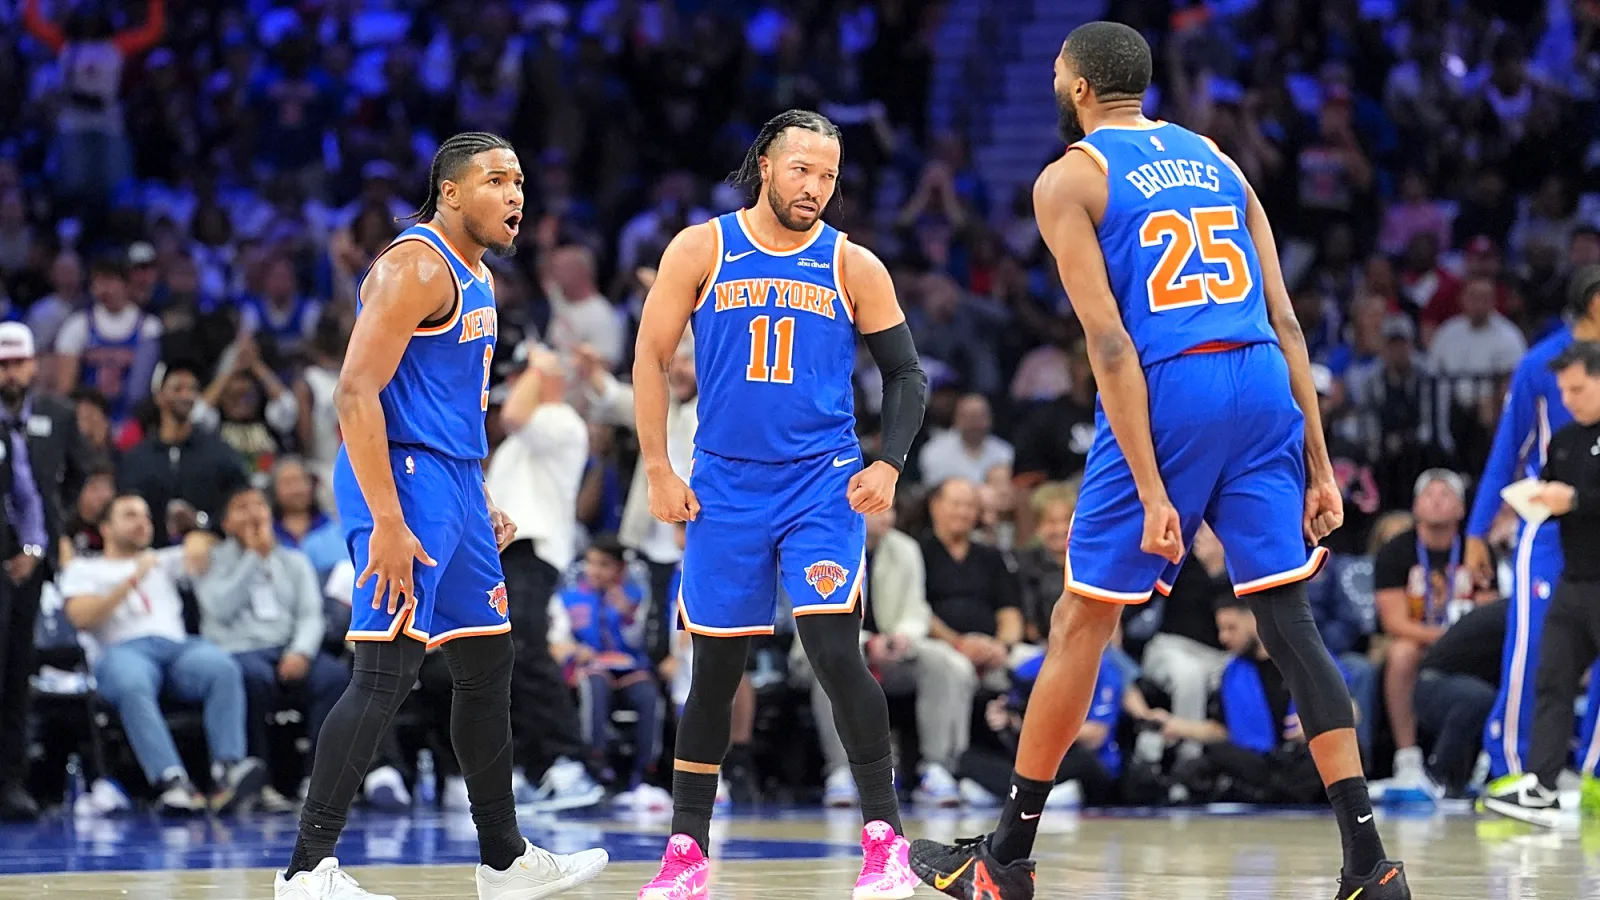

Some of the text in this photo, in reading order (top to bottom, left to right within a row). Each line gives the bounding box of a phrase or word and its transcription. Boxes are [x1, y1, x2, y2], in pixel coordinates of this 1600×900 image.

[1125, 159, 1219, 199] BRIDGES
[1139, 206, 1253, 312] 25
[714, 277, 837, 320] NEW YORK
[746, 315, 795, 384] 11
[808, 564, 846, 582] KNICKS
